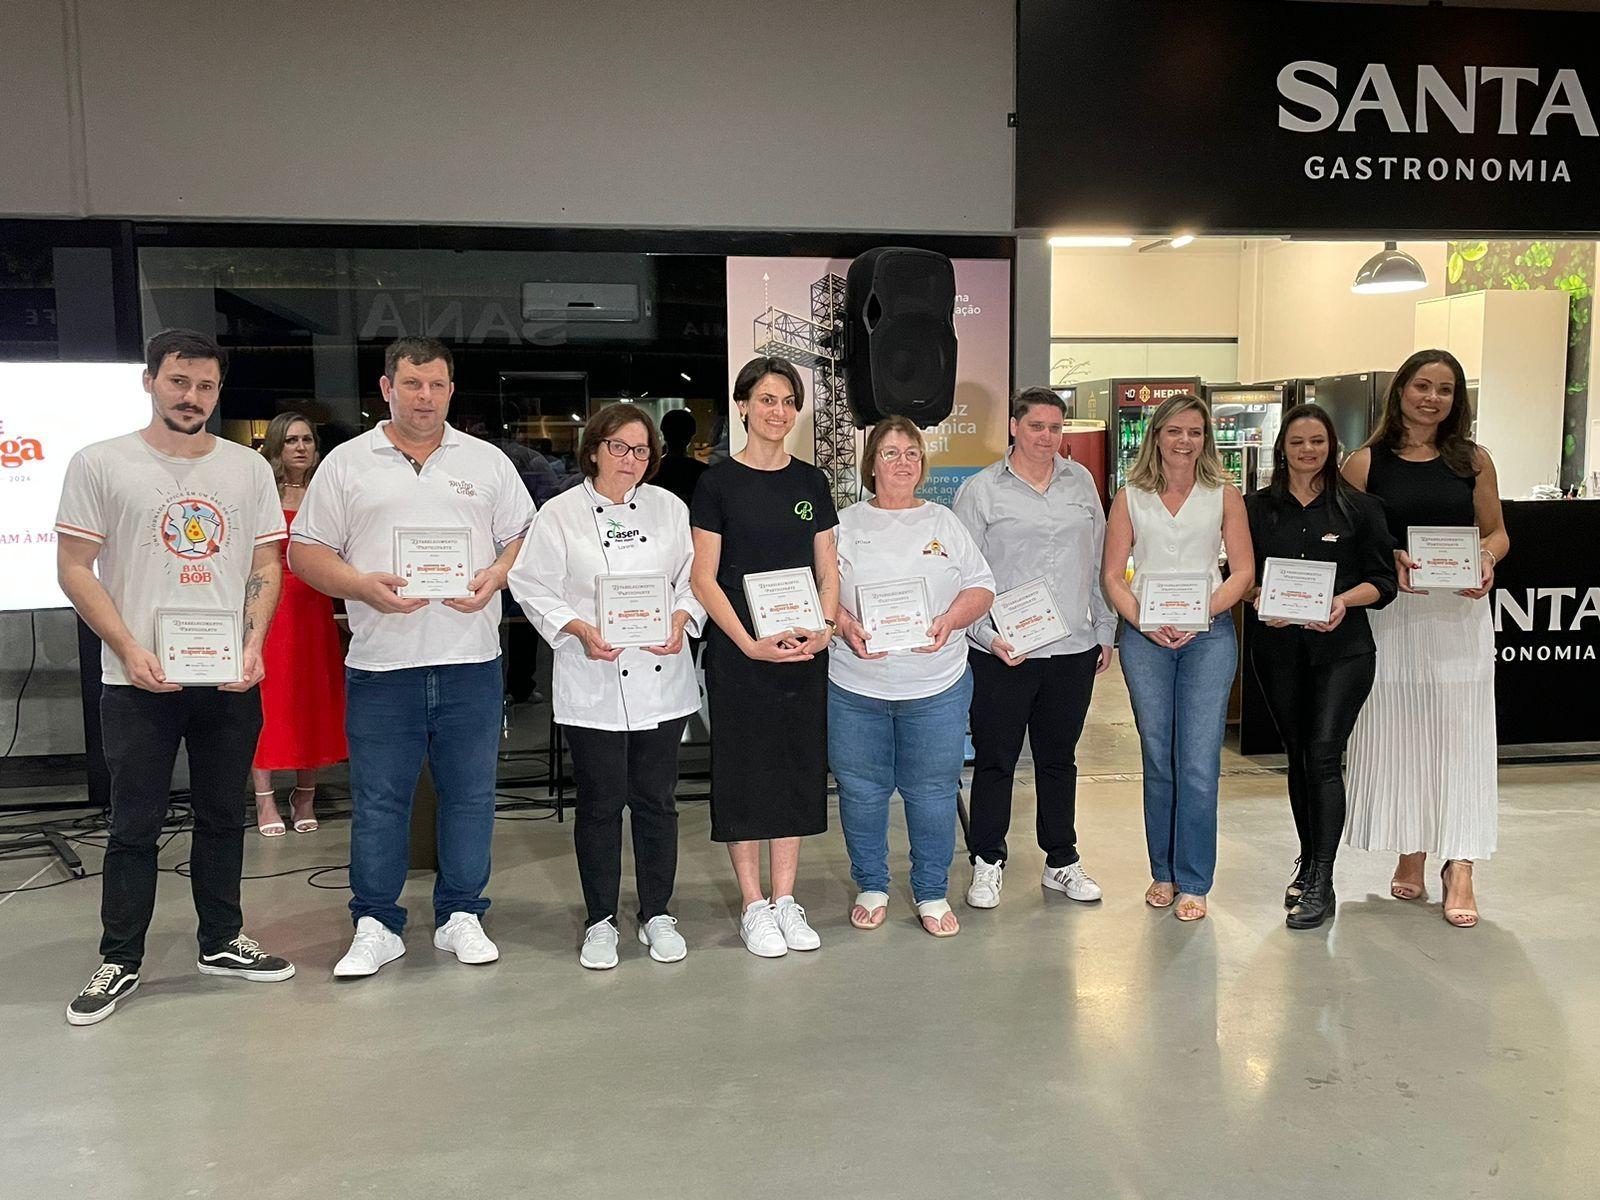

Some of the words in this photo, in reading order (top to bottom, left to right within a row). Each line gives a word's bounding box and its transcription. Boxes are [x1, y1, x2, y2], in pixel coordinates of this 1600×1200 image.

[1276, 60, 1600, 136] SANTA
[1304, 156, 1571, 182] GASTRONOMIA
[180, 572, 212, 583] BOB
